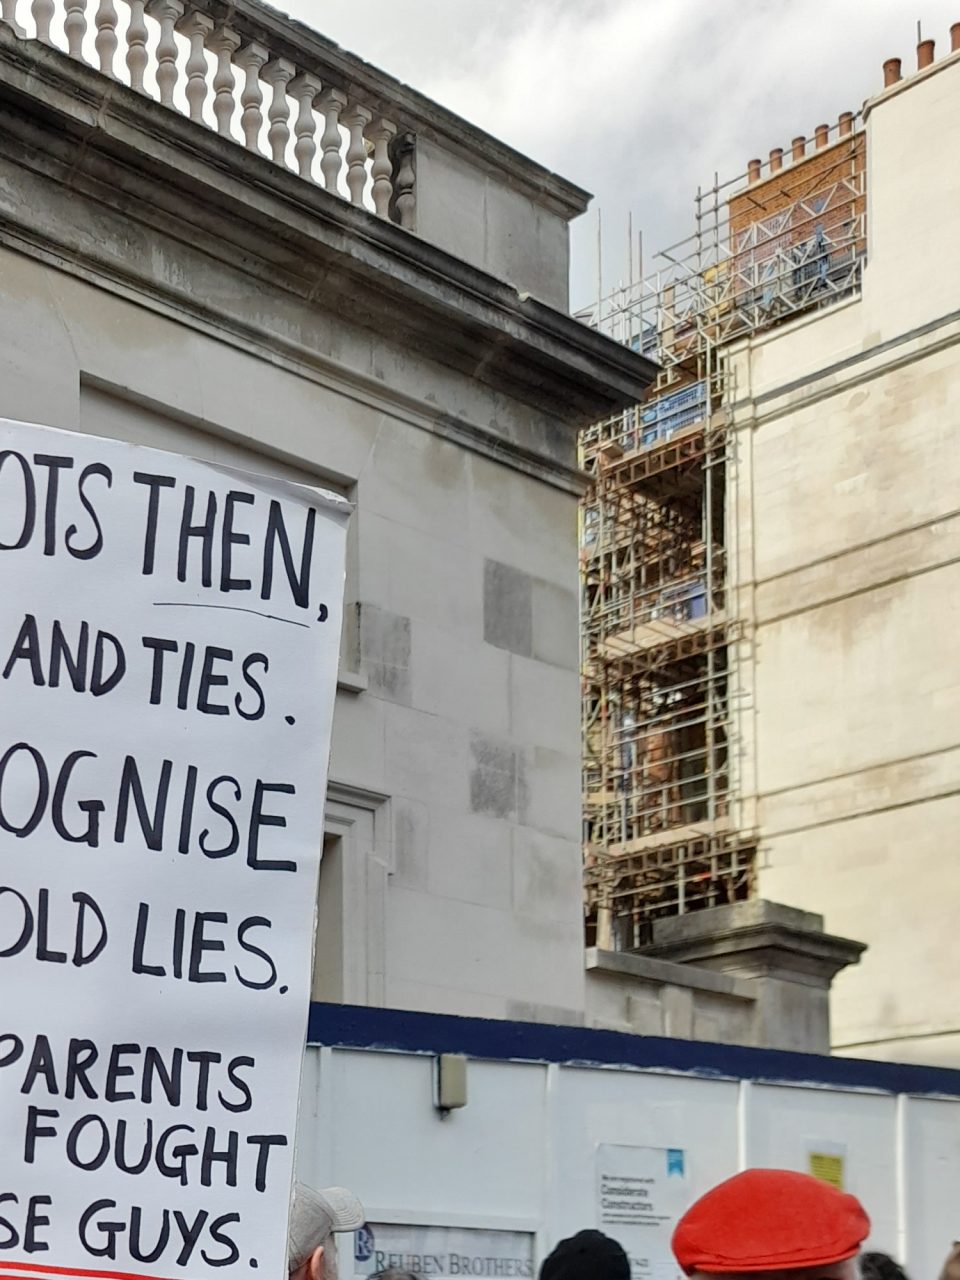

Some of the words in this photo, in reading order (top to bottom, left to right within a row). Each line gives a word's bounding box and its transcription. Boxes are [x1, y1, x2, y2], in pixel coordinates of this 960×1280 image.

[132, 470, 329, 623] THEN,
[1, 613, 127, 698] AND
[141, 636, 298, 726] TIES.
[131, 901, 290, 996] LIES.
[23, 1104, 289, 1193] FOUGHT
[78, 1198, 260, 1269] GUYS.
[375, 1251, 444, 1275] REUBEN
[448, 1253, 534, 1278] BROTHERS
